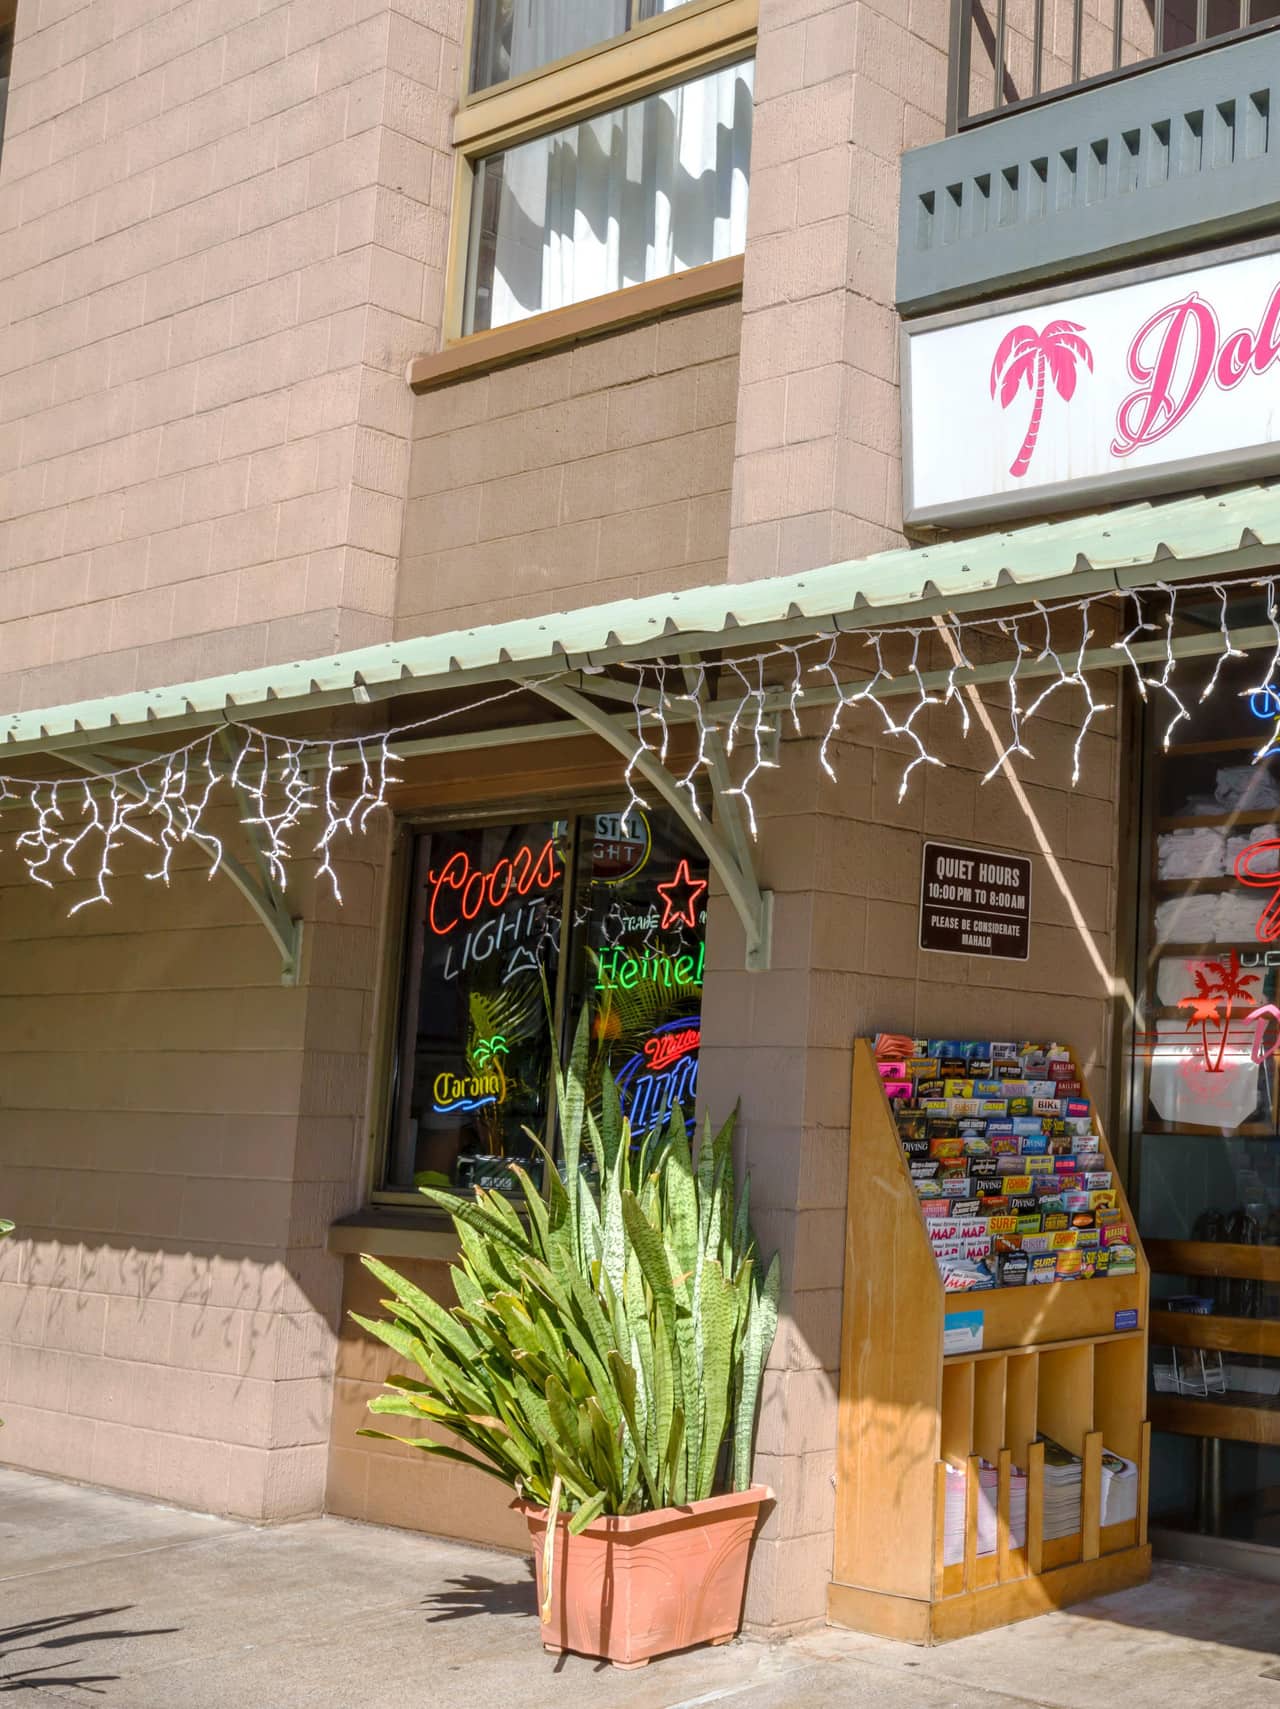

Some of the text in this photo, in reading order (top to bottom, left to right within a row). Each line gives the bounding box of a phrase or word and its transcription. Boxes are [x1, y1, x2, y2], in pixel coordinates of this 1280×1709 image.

[937, 857, 1020, 887] QUIET HOURS
[430, 839, 560, 934] Coors
[929, 883, 986, 904] 10:00 PM TO
[931, 915, 1020, 936] PLEASE BE CONSIDERATE
[444, 898, 546, 980] LIGHT
[962, 934, 991, 947] MAHALO
[434, 1072, 499, 1104] Corona
[961, 1226, 985, 1238] MAP
[990, 1217, 1016, 1230] SURF
[931, 1227, 957, 1240] MAP
[967, 1245, 990, 1259] MAP
[1033, 1257, 1056, 1268] SURF
